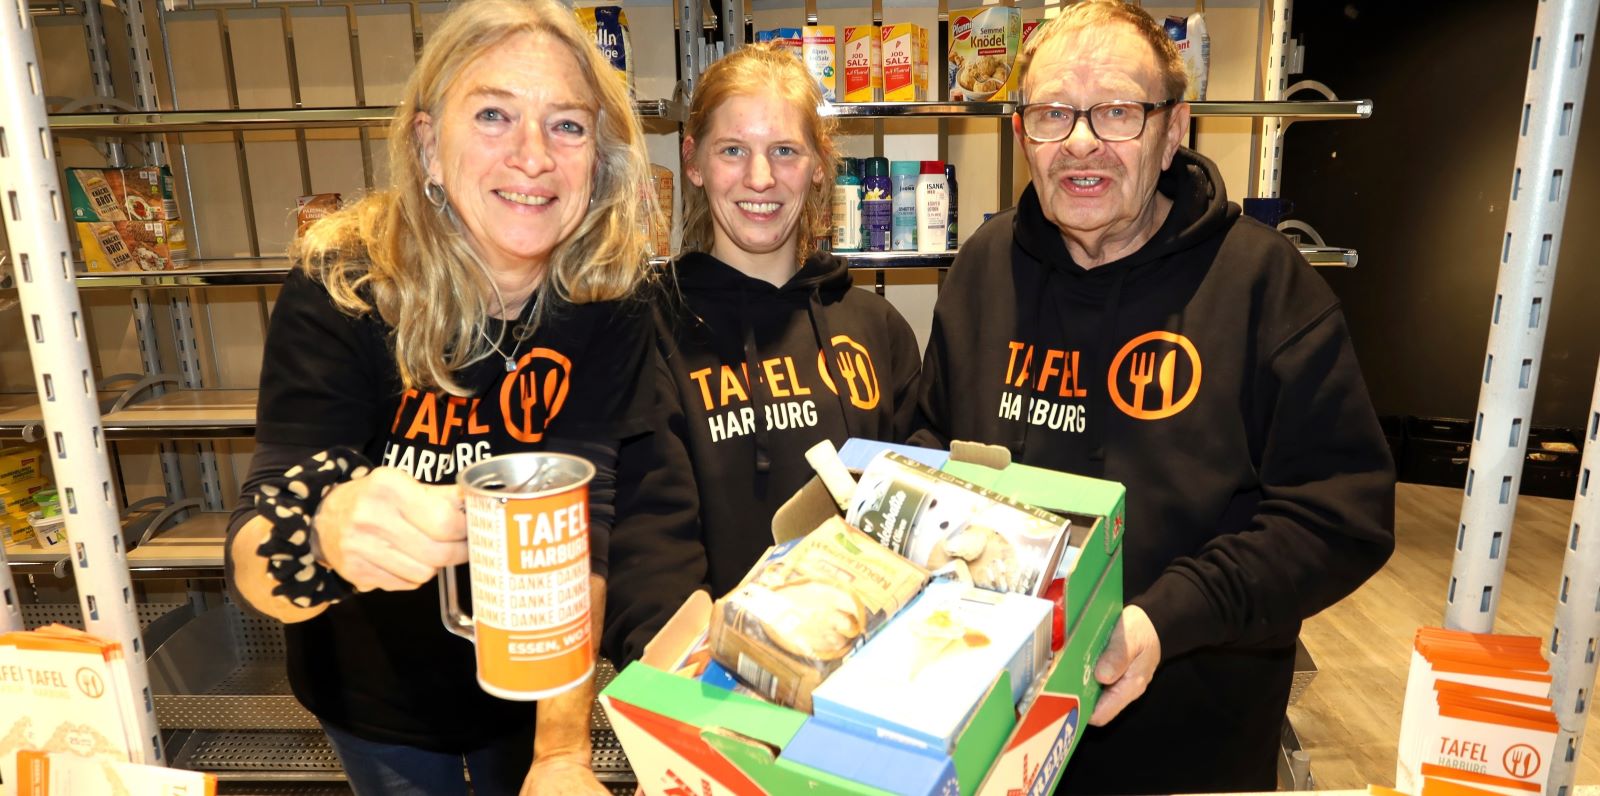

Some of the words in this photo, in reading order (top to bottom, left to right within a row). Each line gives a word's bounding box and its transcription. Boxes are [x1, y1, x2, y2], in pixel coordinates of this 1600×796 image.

[954, 22, 972, 34] Pfanni
[980, 26, 1005, 34] Semmel
[970, 34, 1006, 48] Knödel
[847, 59, 868, 67] SALZ
[886, 57, 909, 65] SALZ
[95, 194, 114, 207] BROT
[105, 242, 124, 255] BROT
[690, 356, 811, 411] TAEL
[391, 387, 490, 446] TAFL
[512, 501, 588, 547] TAFEL
[509, 575, 553, 591] DANKE
[510, 592, 554, 609] DANKE
[511, 609, 555, 627] DANKE
[508, 639, 561, 654] ESSEN,
[27, 669, 67, 689] TAFEL
[1440, 736, 1488, 763] TAFEL
[1438, 757, 1488, 775] HARBURG
